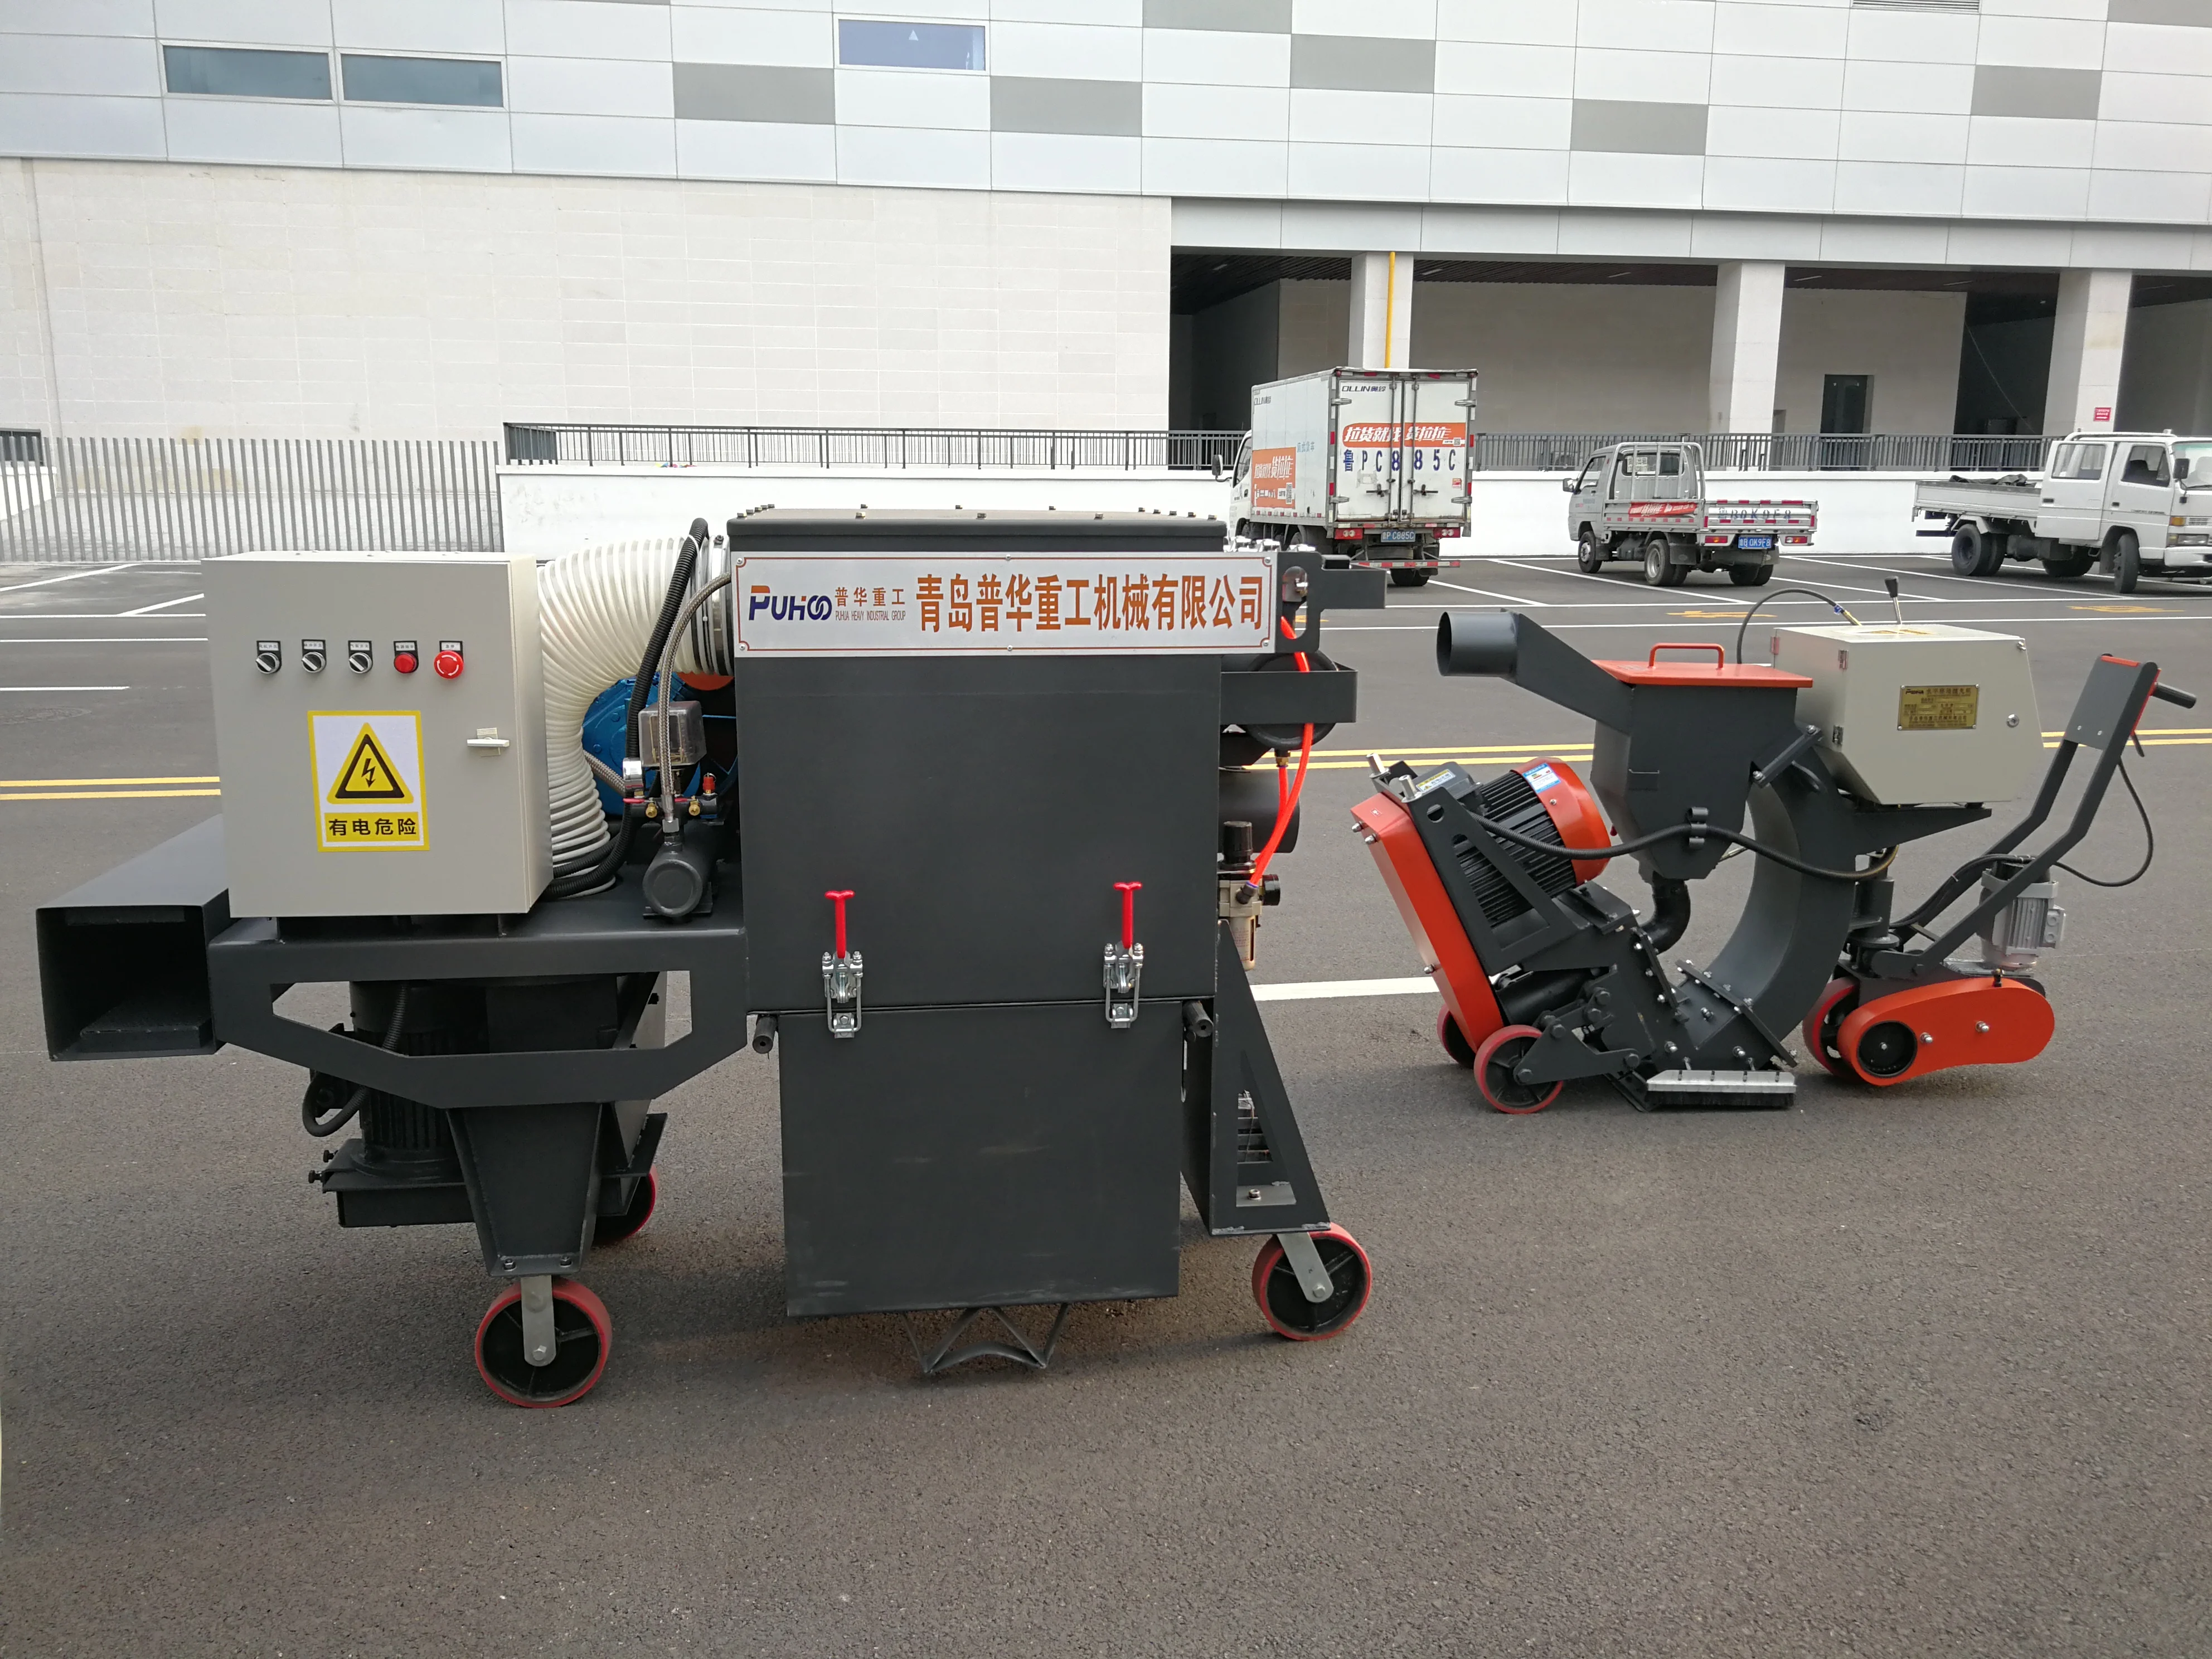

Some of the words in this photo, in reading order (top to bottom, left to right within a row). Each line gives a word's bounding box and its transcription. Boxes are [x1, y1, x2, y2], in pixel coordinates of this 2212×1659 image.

[835, 586, 905, 607] 普华重工
[916, 573, 1263, 633] 青岛普华重工机械有限公司
[835, 610, 850, 621] PUHUA
[851, 610, 864, 621] HEAVY
[866, 610, 889, 621] INDUSTRIAL
[891, 610, 906, 621] GROUP
[328, 818, 416, 836] 有电危险
